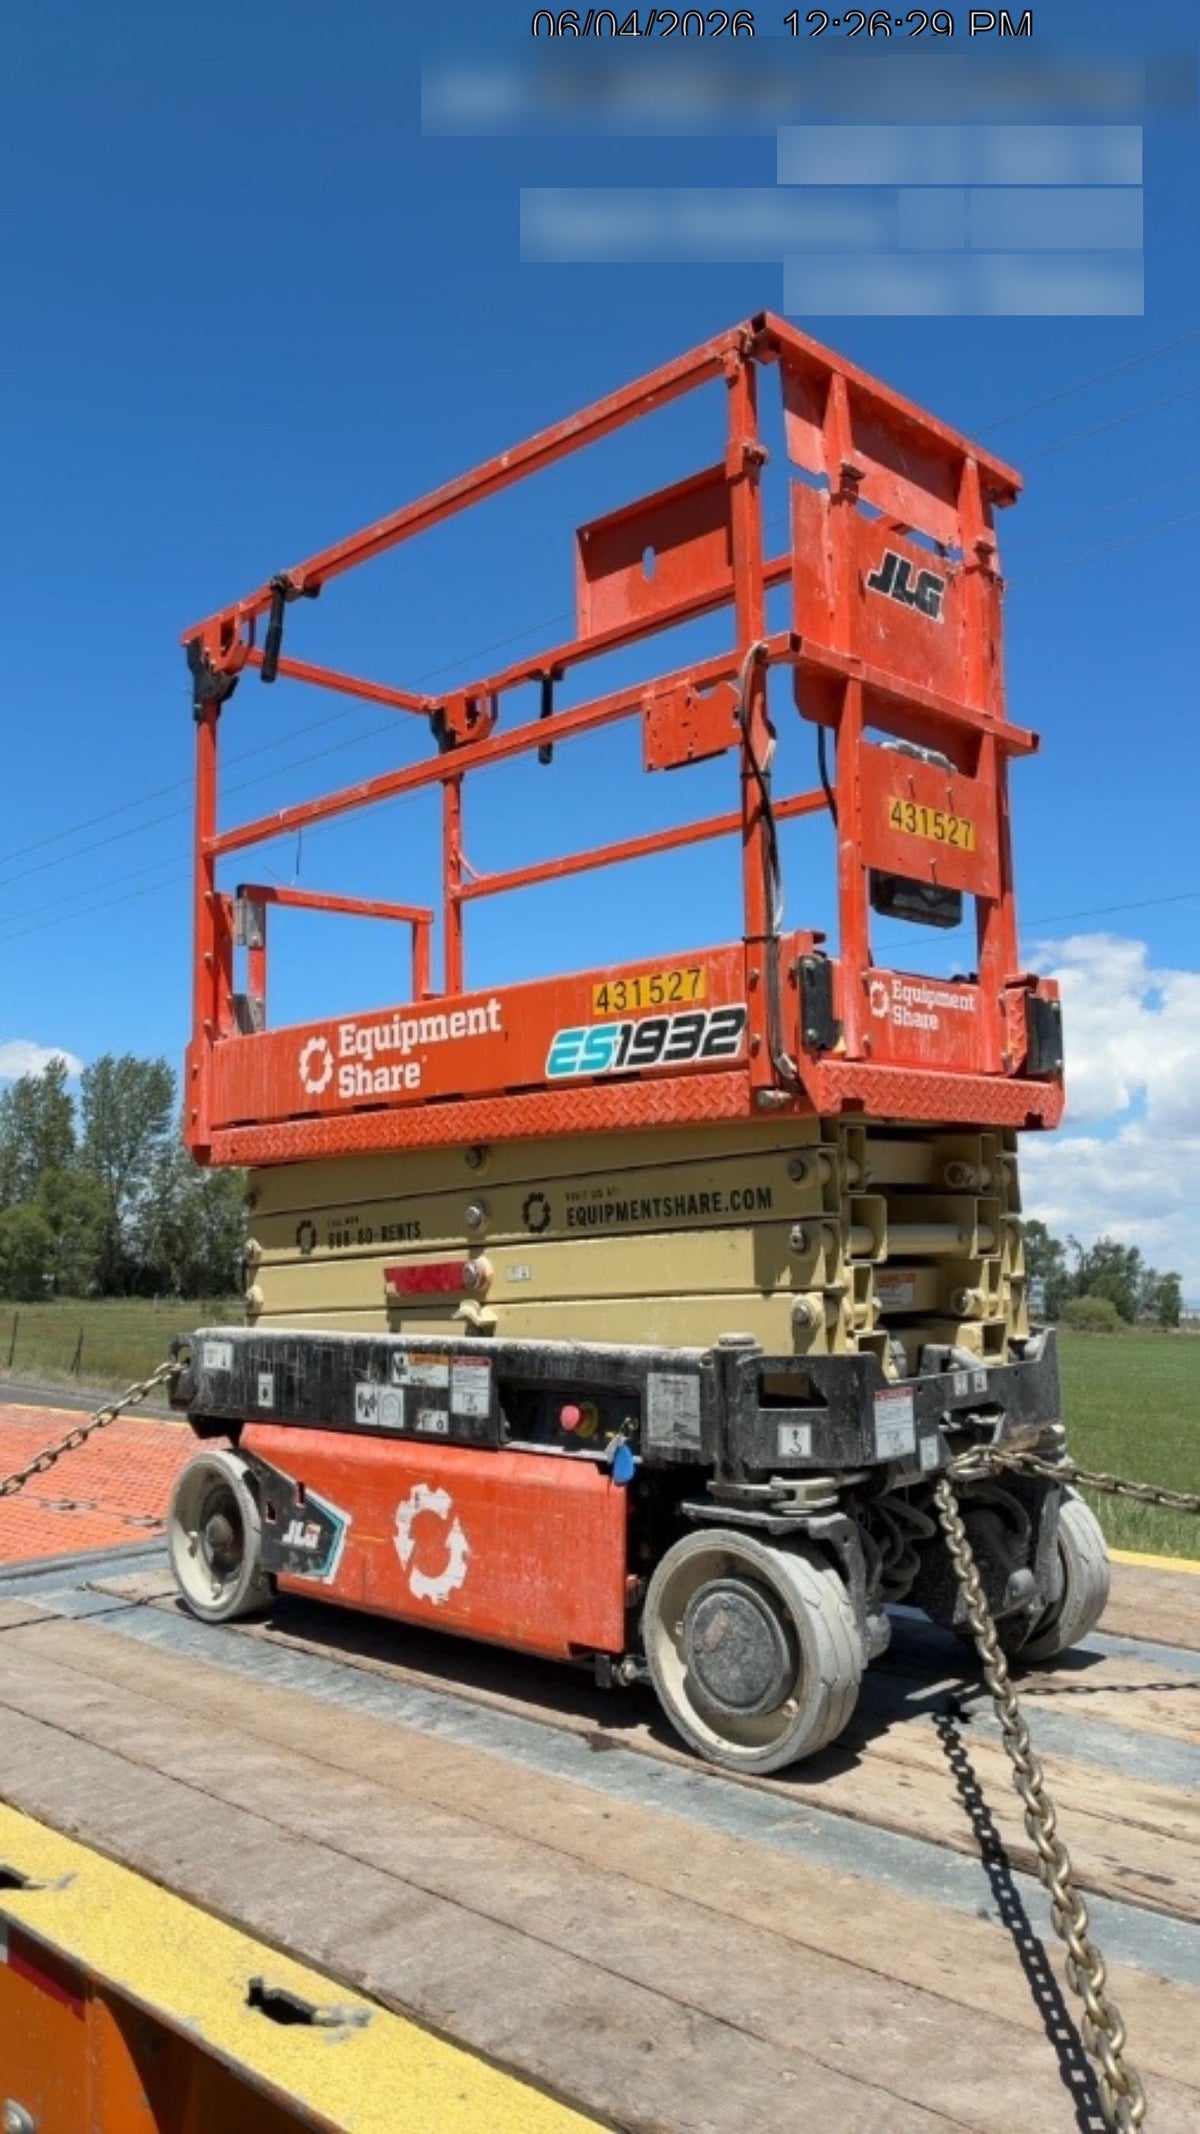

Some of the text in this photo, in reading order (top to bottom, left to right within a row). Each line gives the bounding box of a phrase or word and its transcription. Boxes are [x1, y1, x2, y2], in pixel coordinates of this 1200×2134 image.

[866, 549, 946, 623] JLG
[891, 800, 972, 847] 431527
[595, 969, 702, 1012] 431527
[891, 979, 976, 1012] Equipment
[338, 998, 502, 1060] Equipment
[892, 1006, 939, 1030] Share
[546, 1003, 748, 1079] ES1932
[338, 1061, 421, 1098] Share
[566, 1187, 773, 1227] EQUIPMENTSHARE.COM
[281, 1520, 321, 1549] JLG
